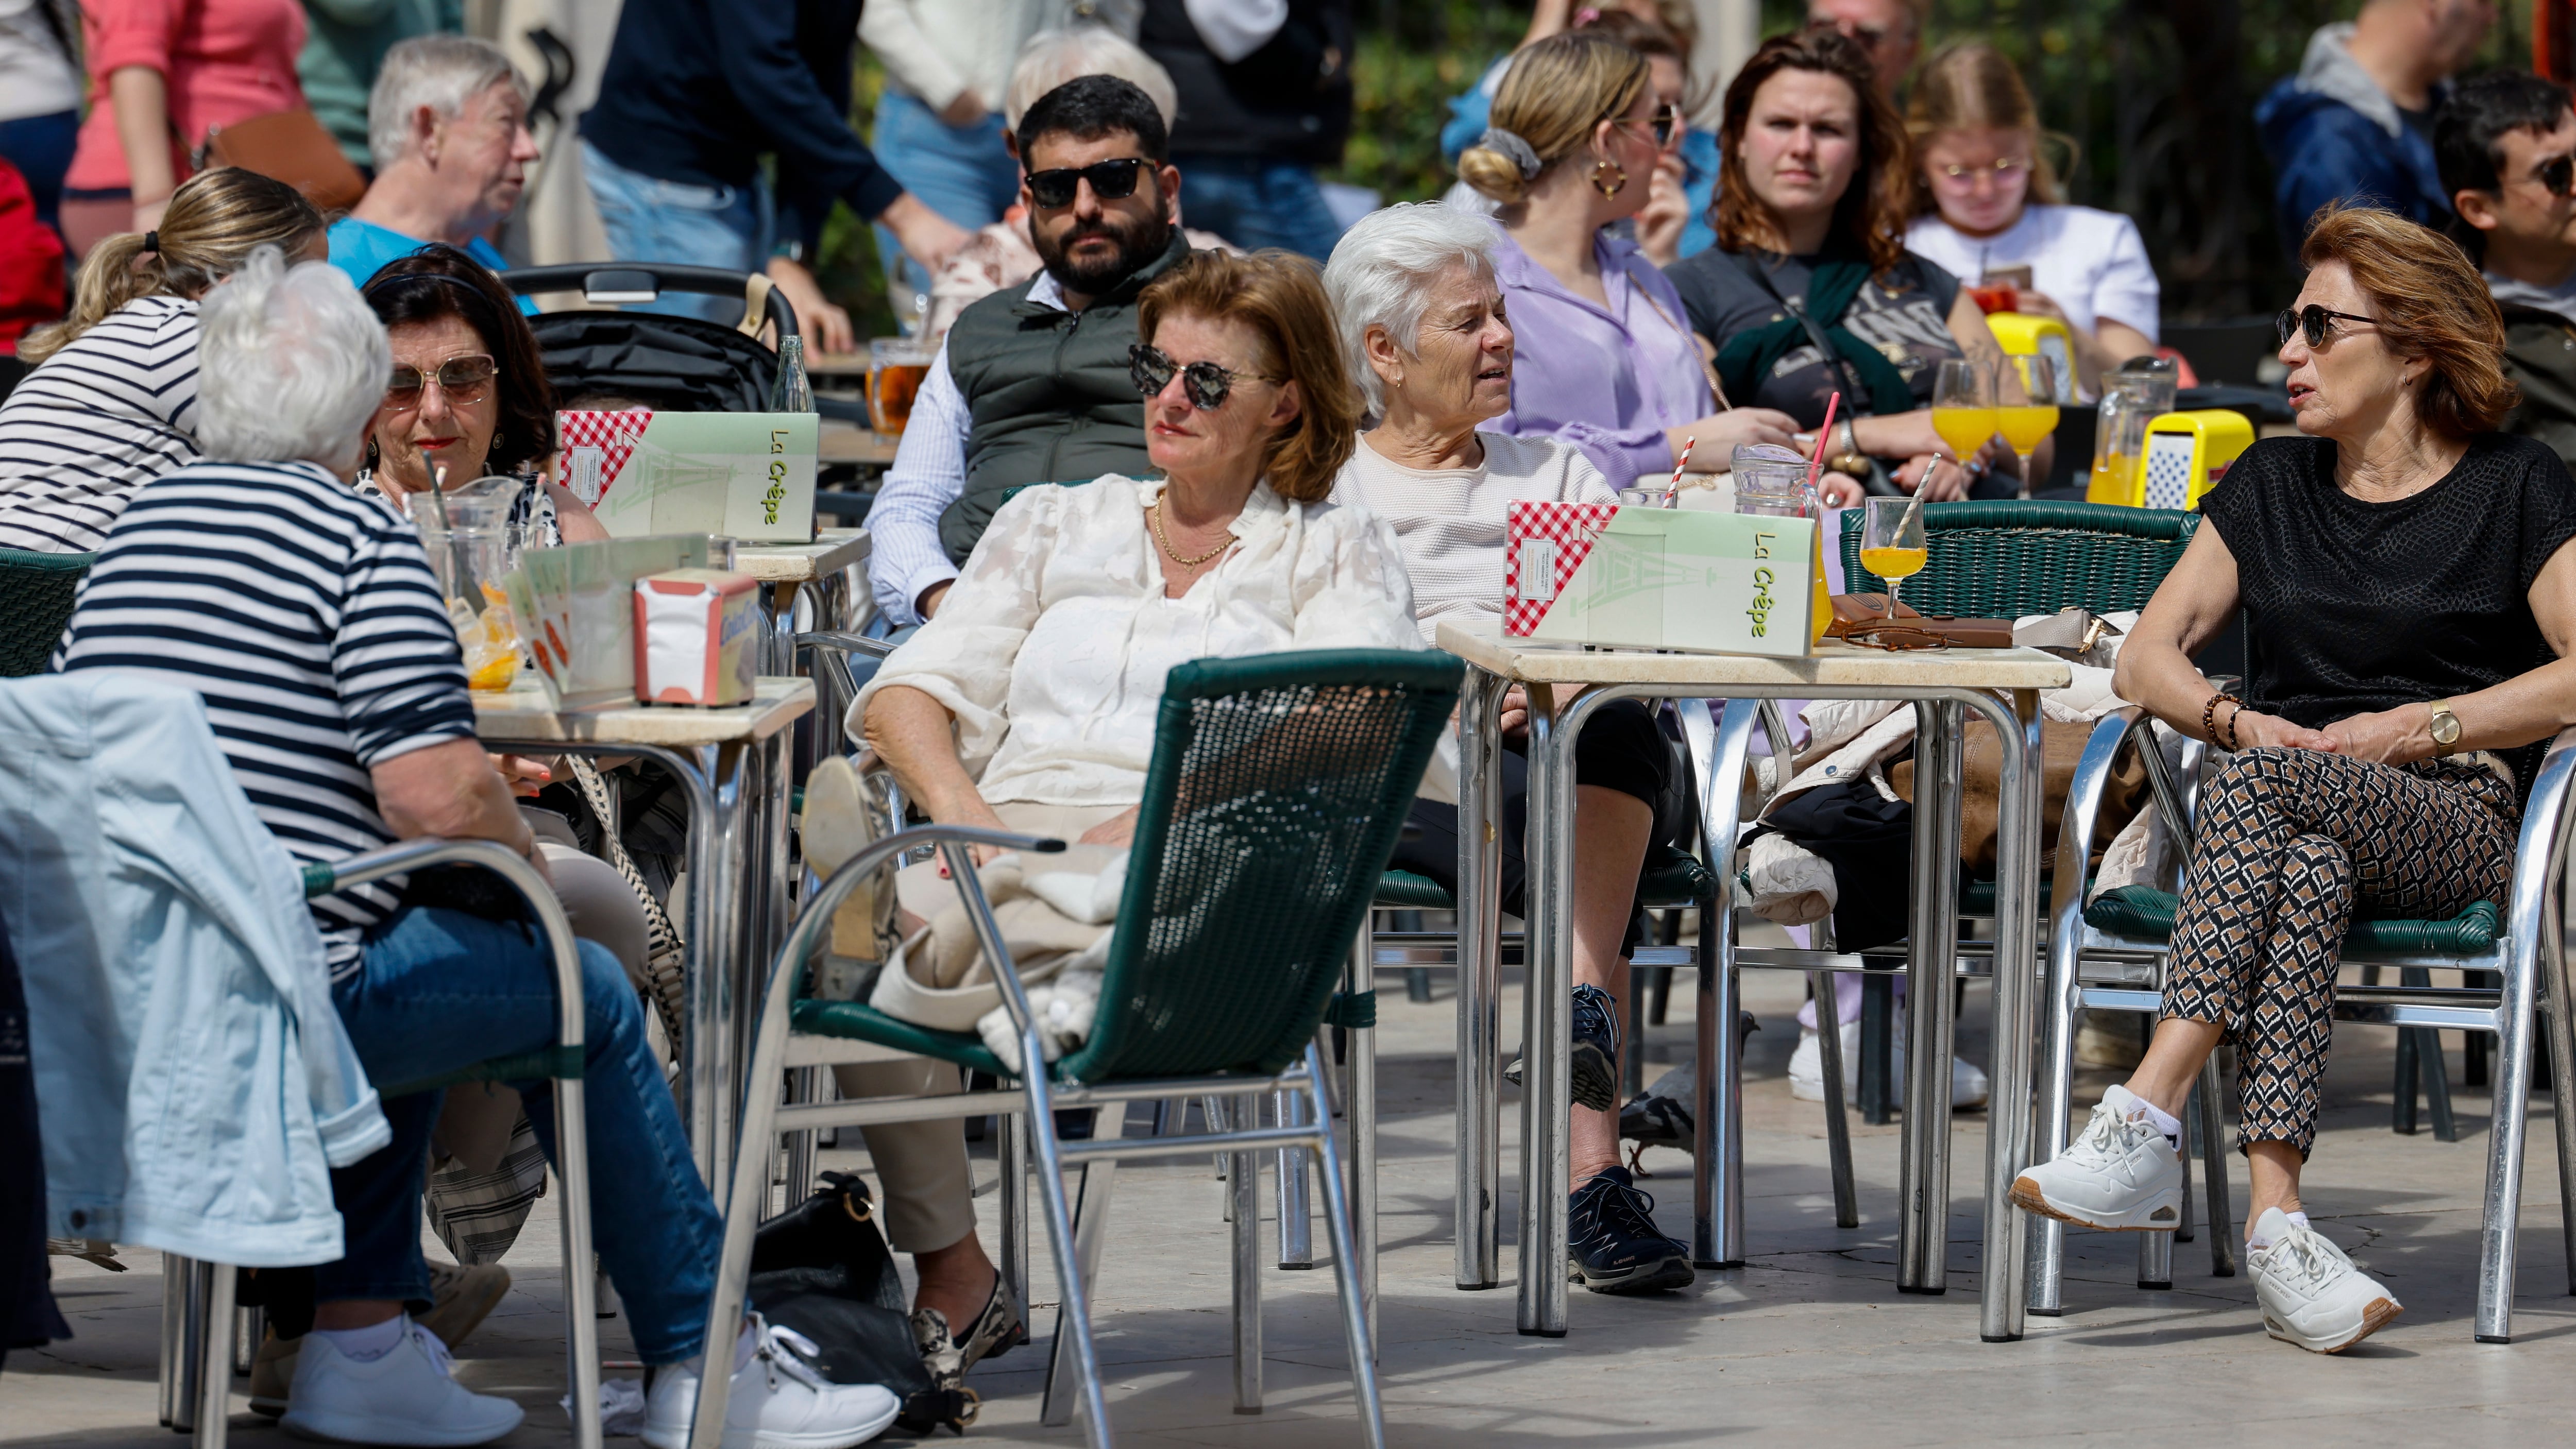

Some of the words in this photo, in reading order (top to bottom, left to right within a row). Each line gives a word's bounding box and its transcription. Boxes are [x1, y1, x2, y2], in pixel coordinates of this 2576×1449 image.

[771, 429, 790, 454] La
[761, 459, 788, 525] Crêpe
[1755, 532, 1778, 559] La
[1747, 567, 1775, 637] Crêpe
[2120, 1154, 2143, 1173] SKCHERS
[1613, 1255, 1635, 1266] LOWA
